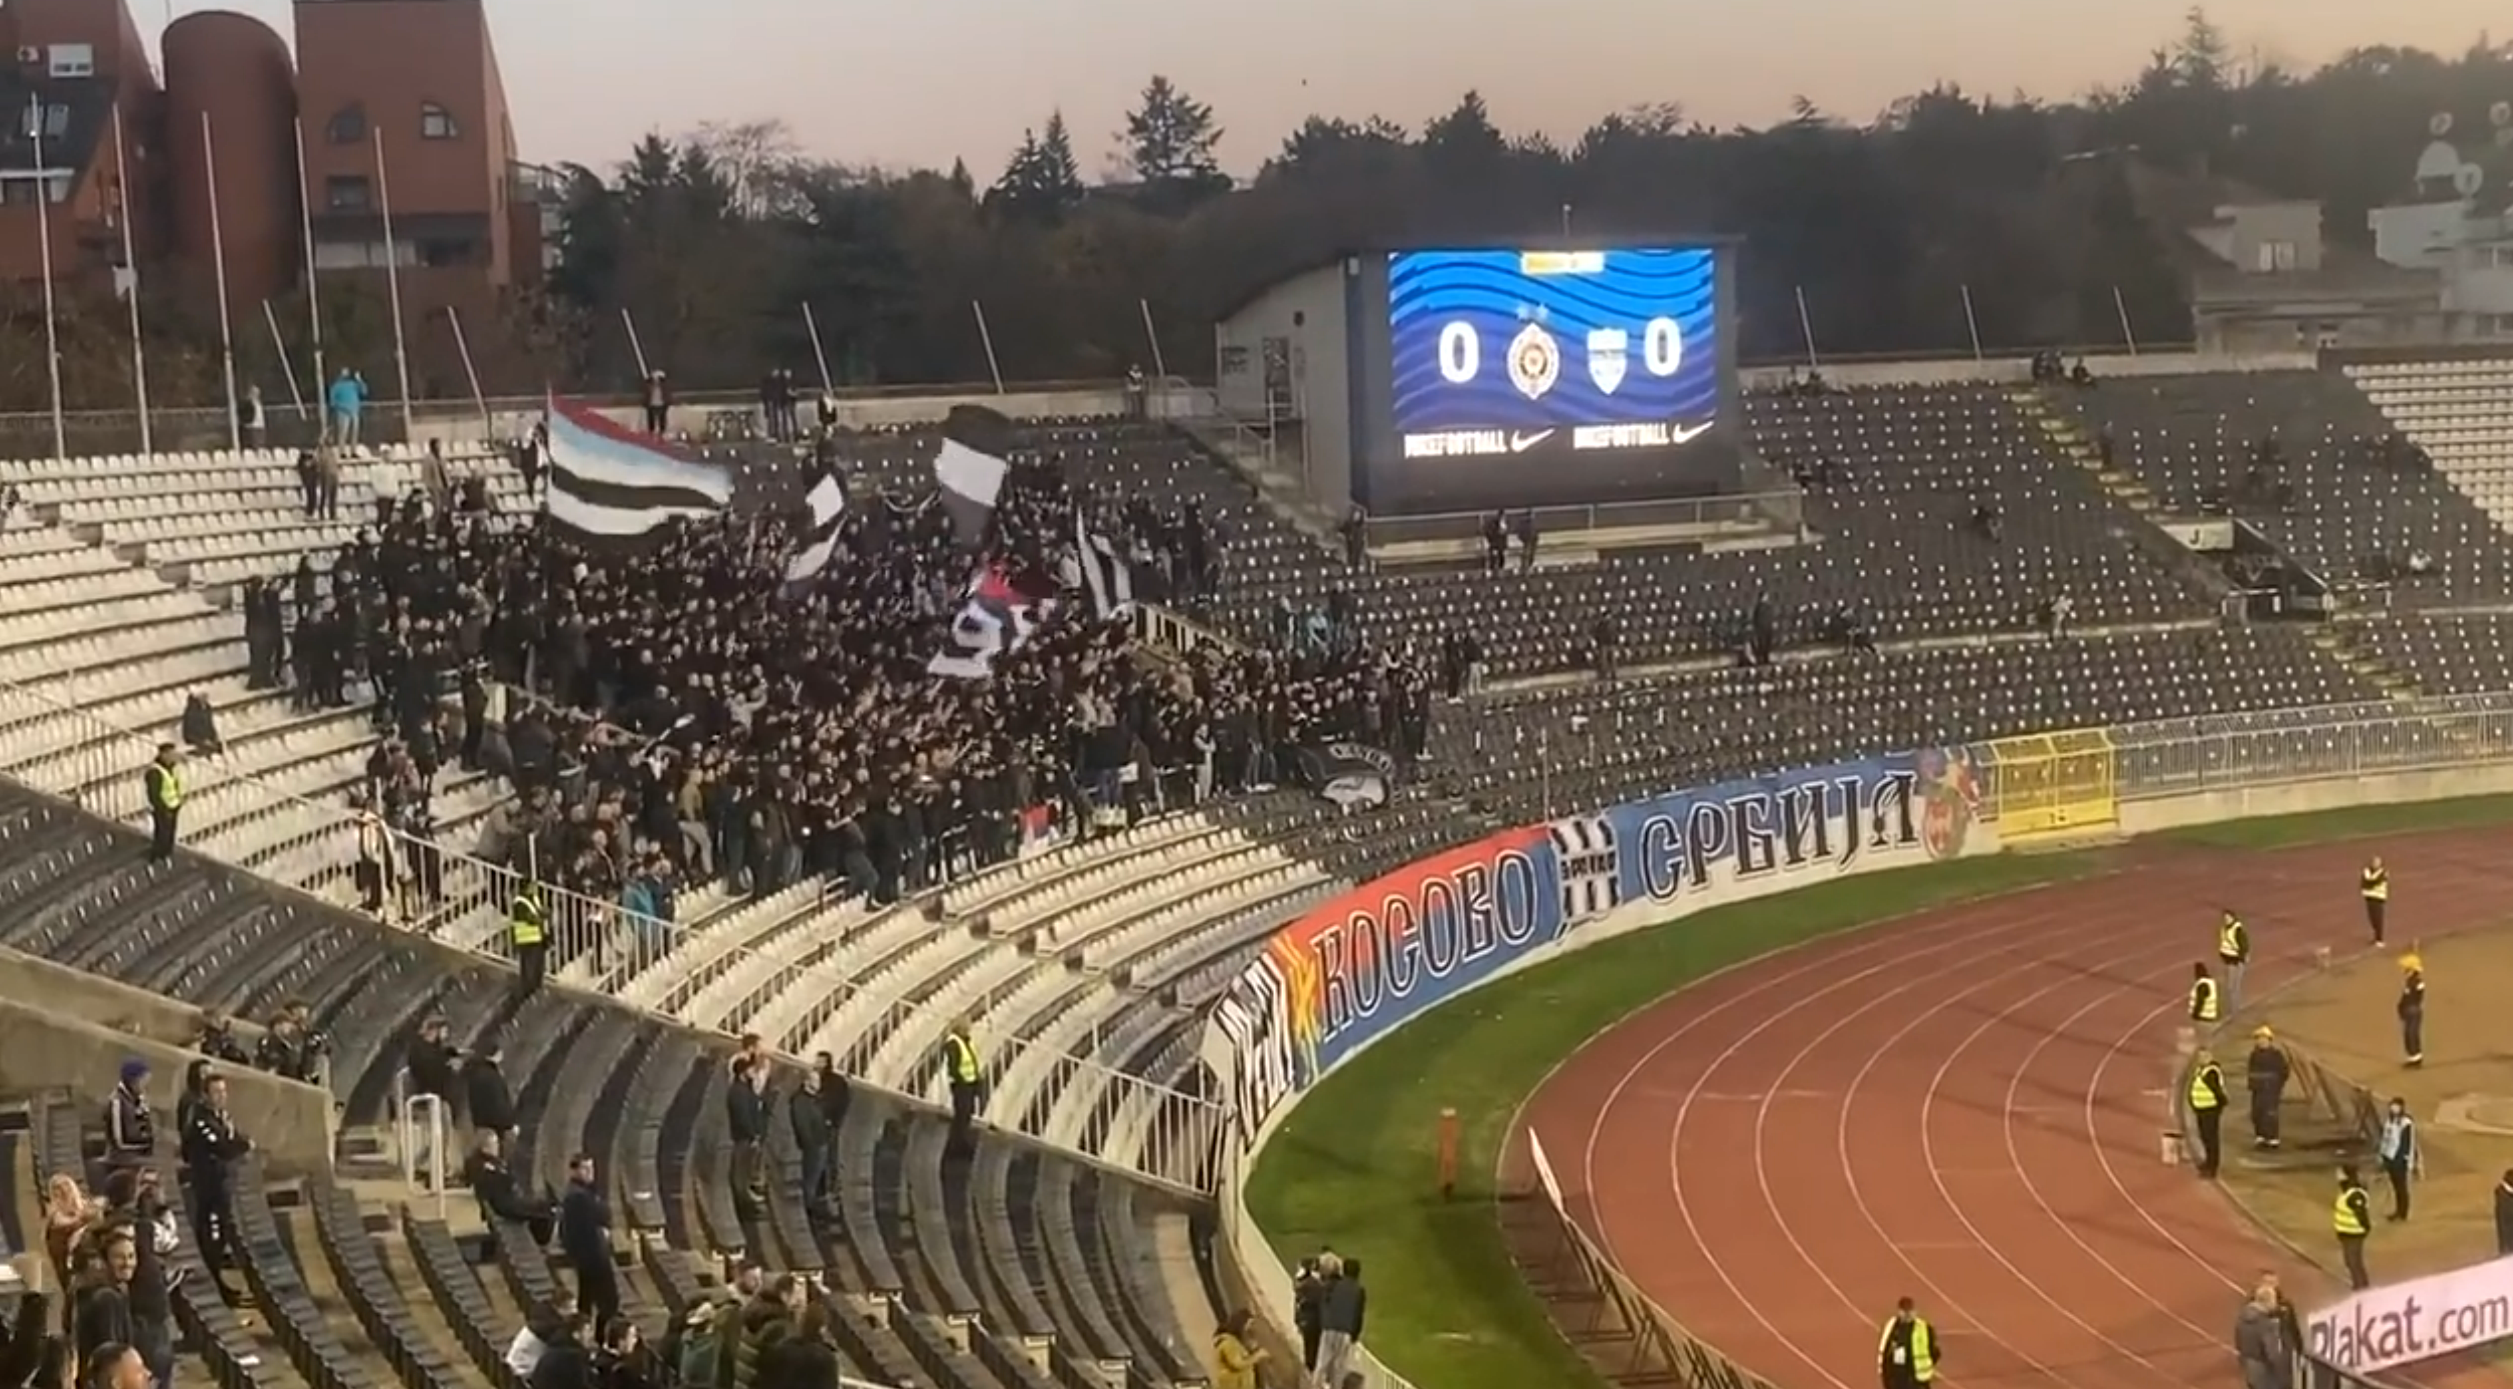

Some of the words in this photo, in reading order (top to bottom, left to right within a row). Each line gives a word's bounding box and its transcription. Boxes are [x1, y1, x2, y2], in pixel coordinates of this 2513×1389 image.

[1439, 320, 1479, 383] 0
[1645, 316, 1682, 377] 0
[1639, 770, 1918, 905] СРБИЈА
[1310, 850, 1538, 1043] КОСОВО
